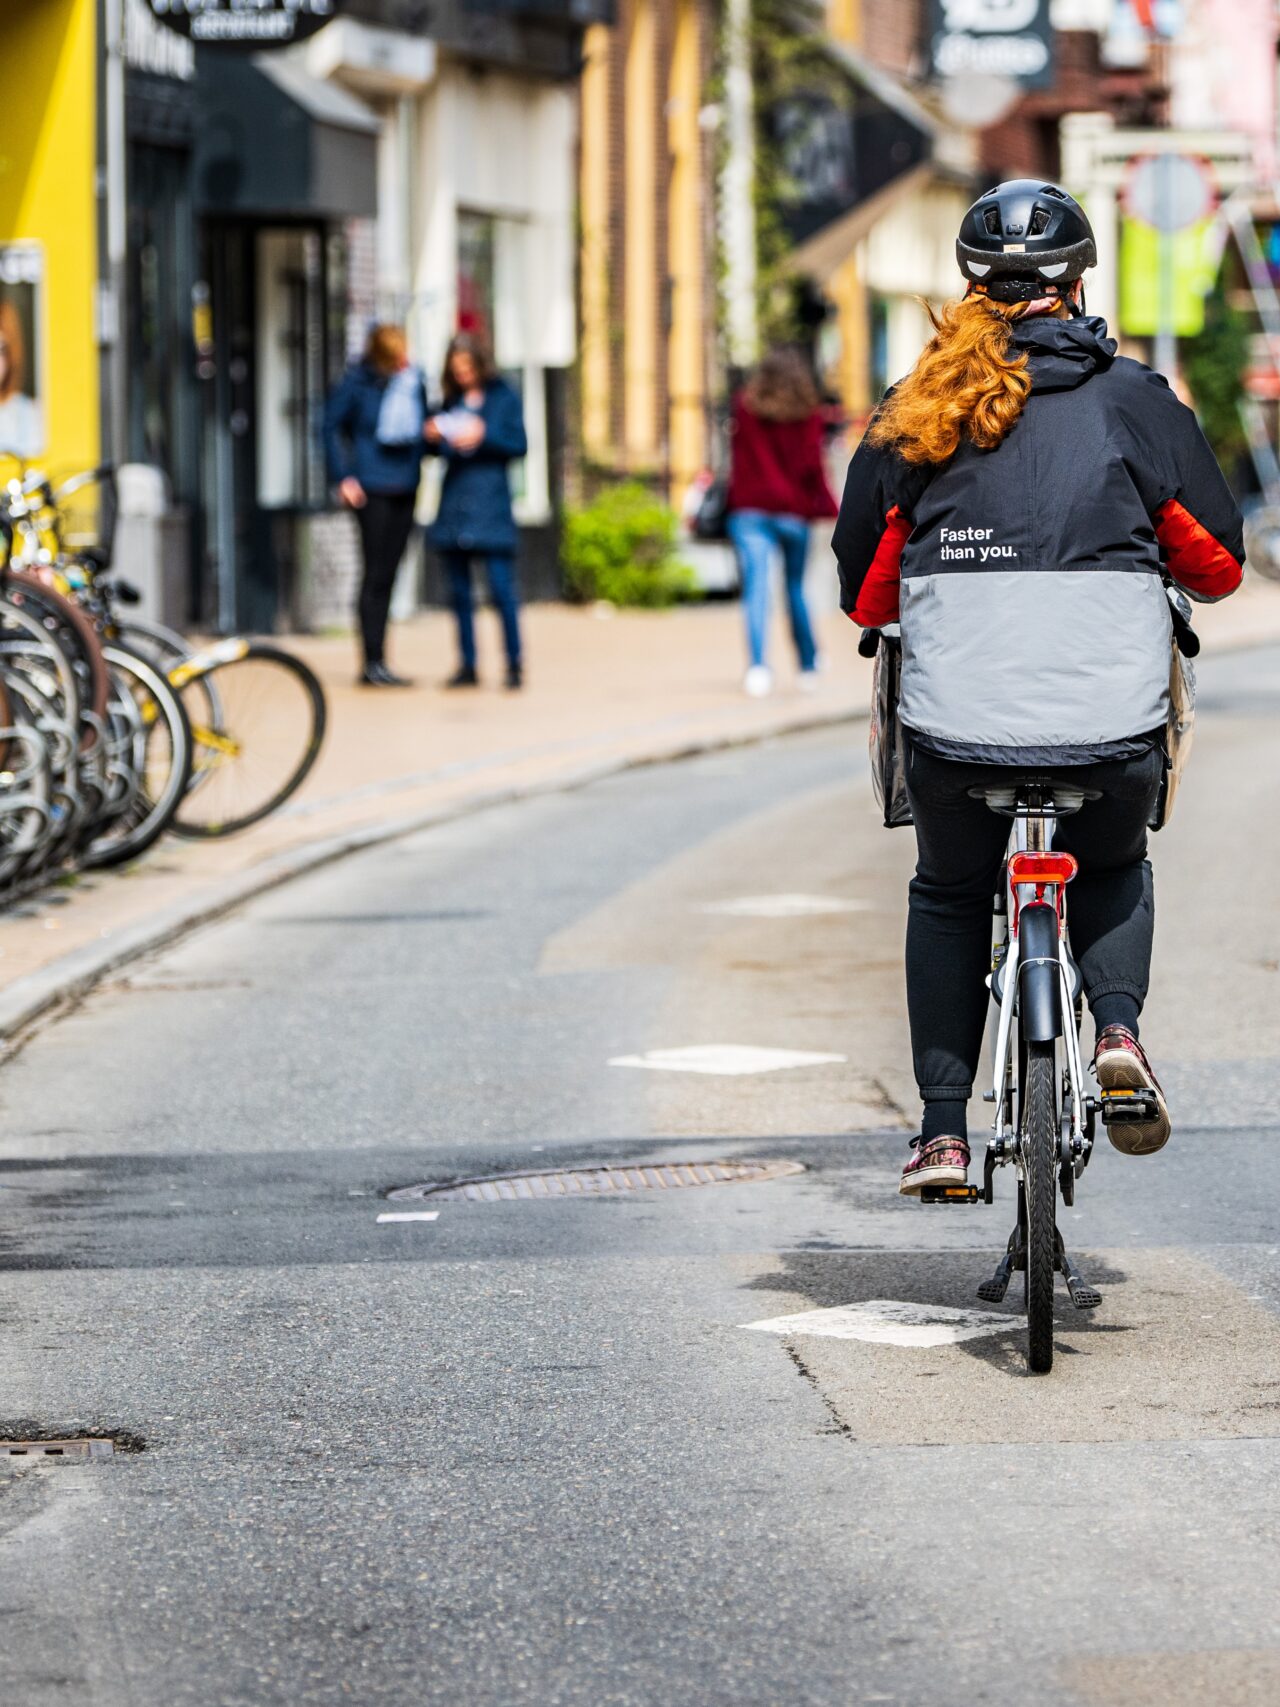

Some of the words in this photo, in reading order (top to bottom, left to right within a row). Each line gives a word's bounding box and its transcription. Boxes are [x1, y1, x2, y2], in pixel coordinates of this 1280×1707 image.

[940, 527, 993, 542] Faster
[940, 545, 975, 560] than
[979, 546, 1017, 562] you.
